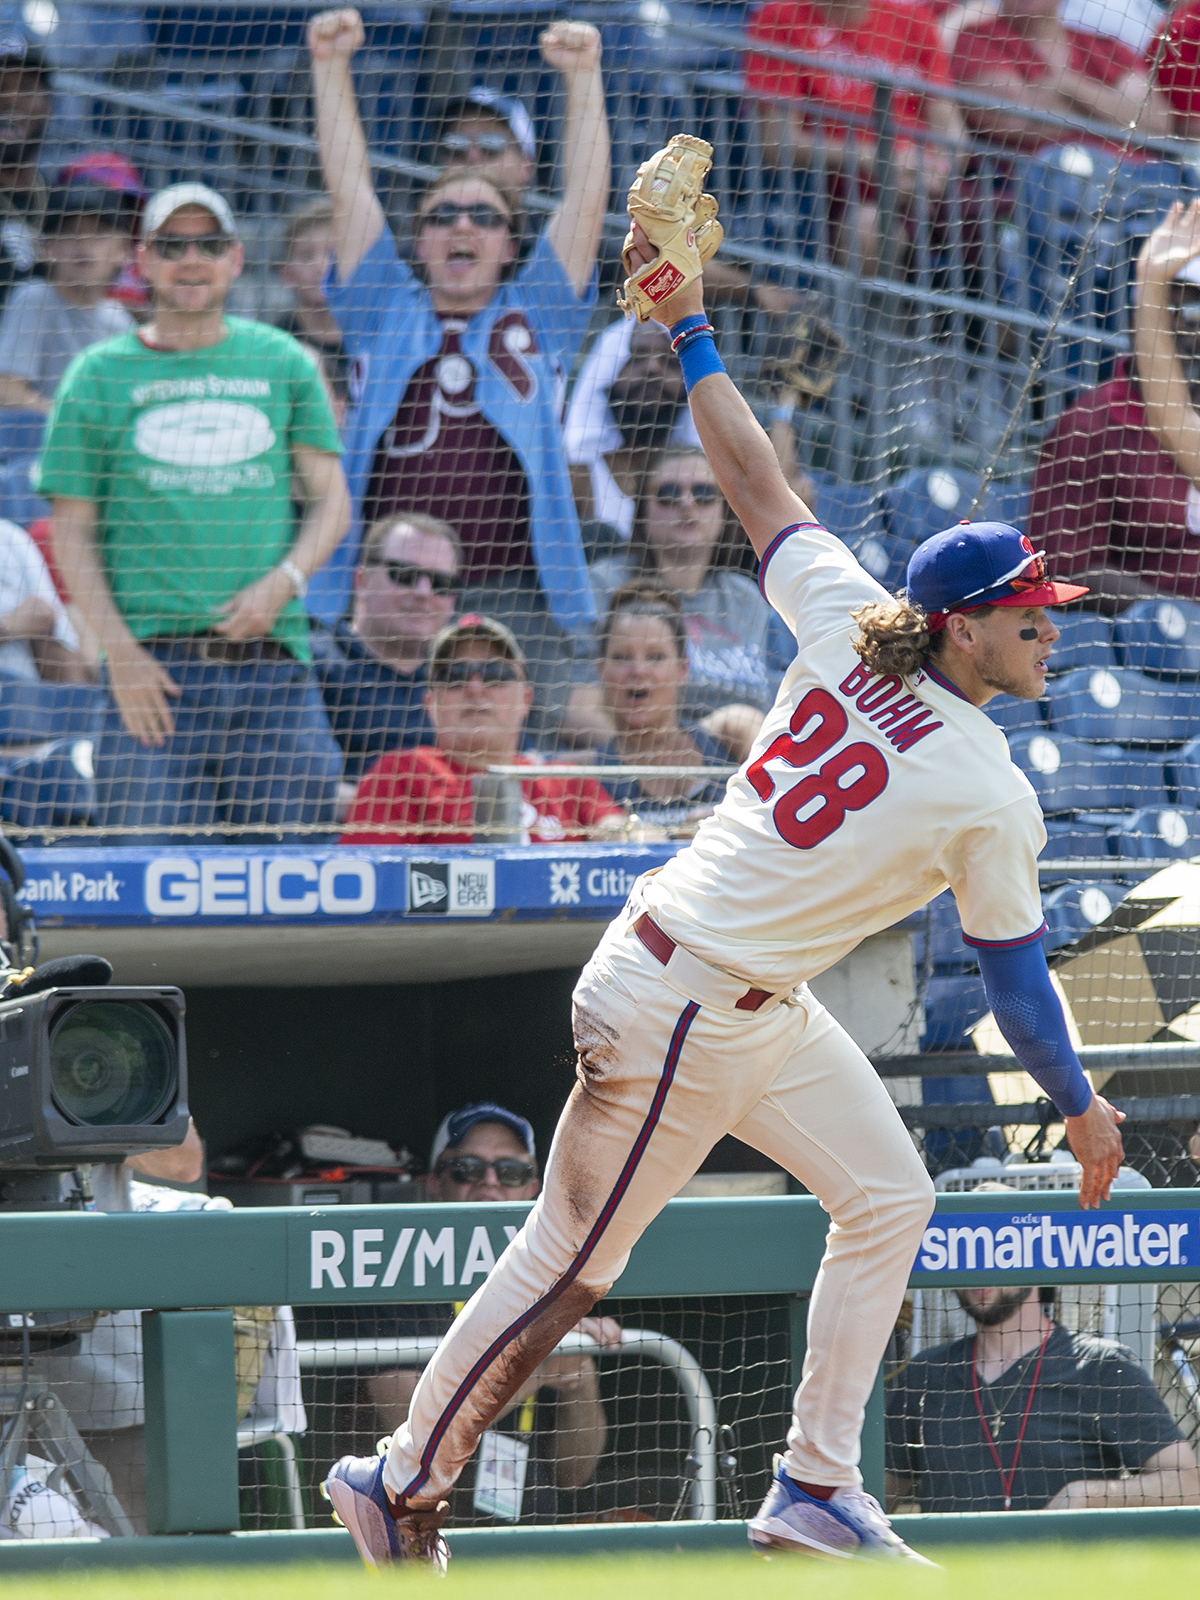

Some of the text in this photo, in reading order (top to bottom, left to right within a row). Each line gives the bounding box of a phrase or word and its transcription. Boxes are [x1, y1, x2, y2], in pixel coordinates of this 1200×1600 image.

[838, 661, 944, 754] BOHM
[746, 687, 890, 850] 28
[70, 871, 121, 901] Park
[145, 859, 376, 916] GEICO
[457, 872, 488, 889] NEW
[457, 889, 488, 906] ERA
[921, 1214, 1188, 1270] smartwater
